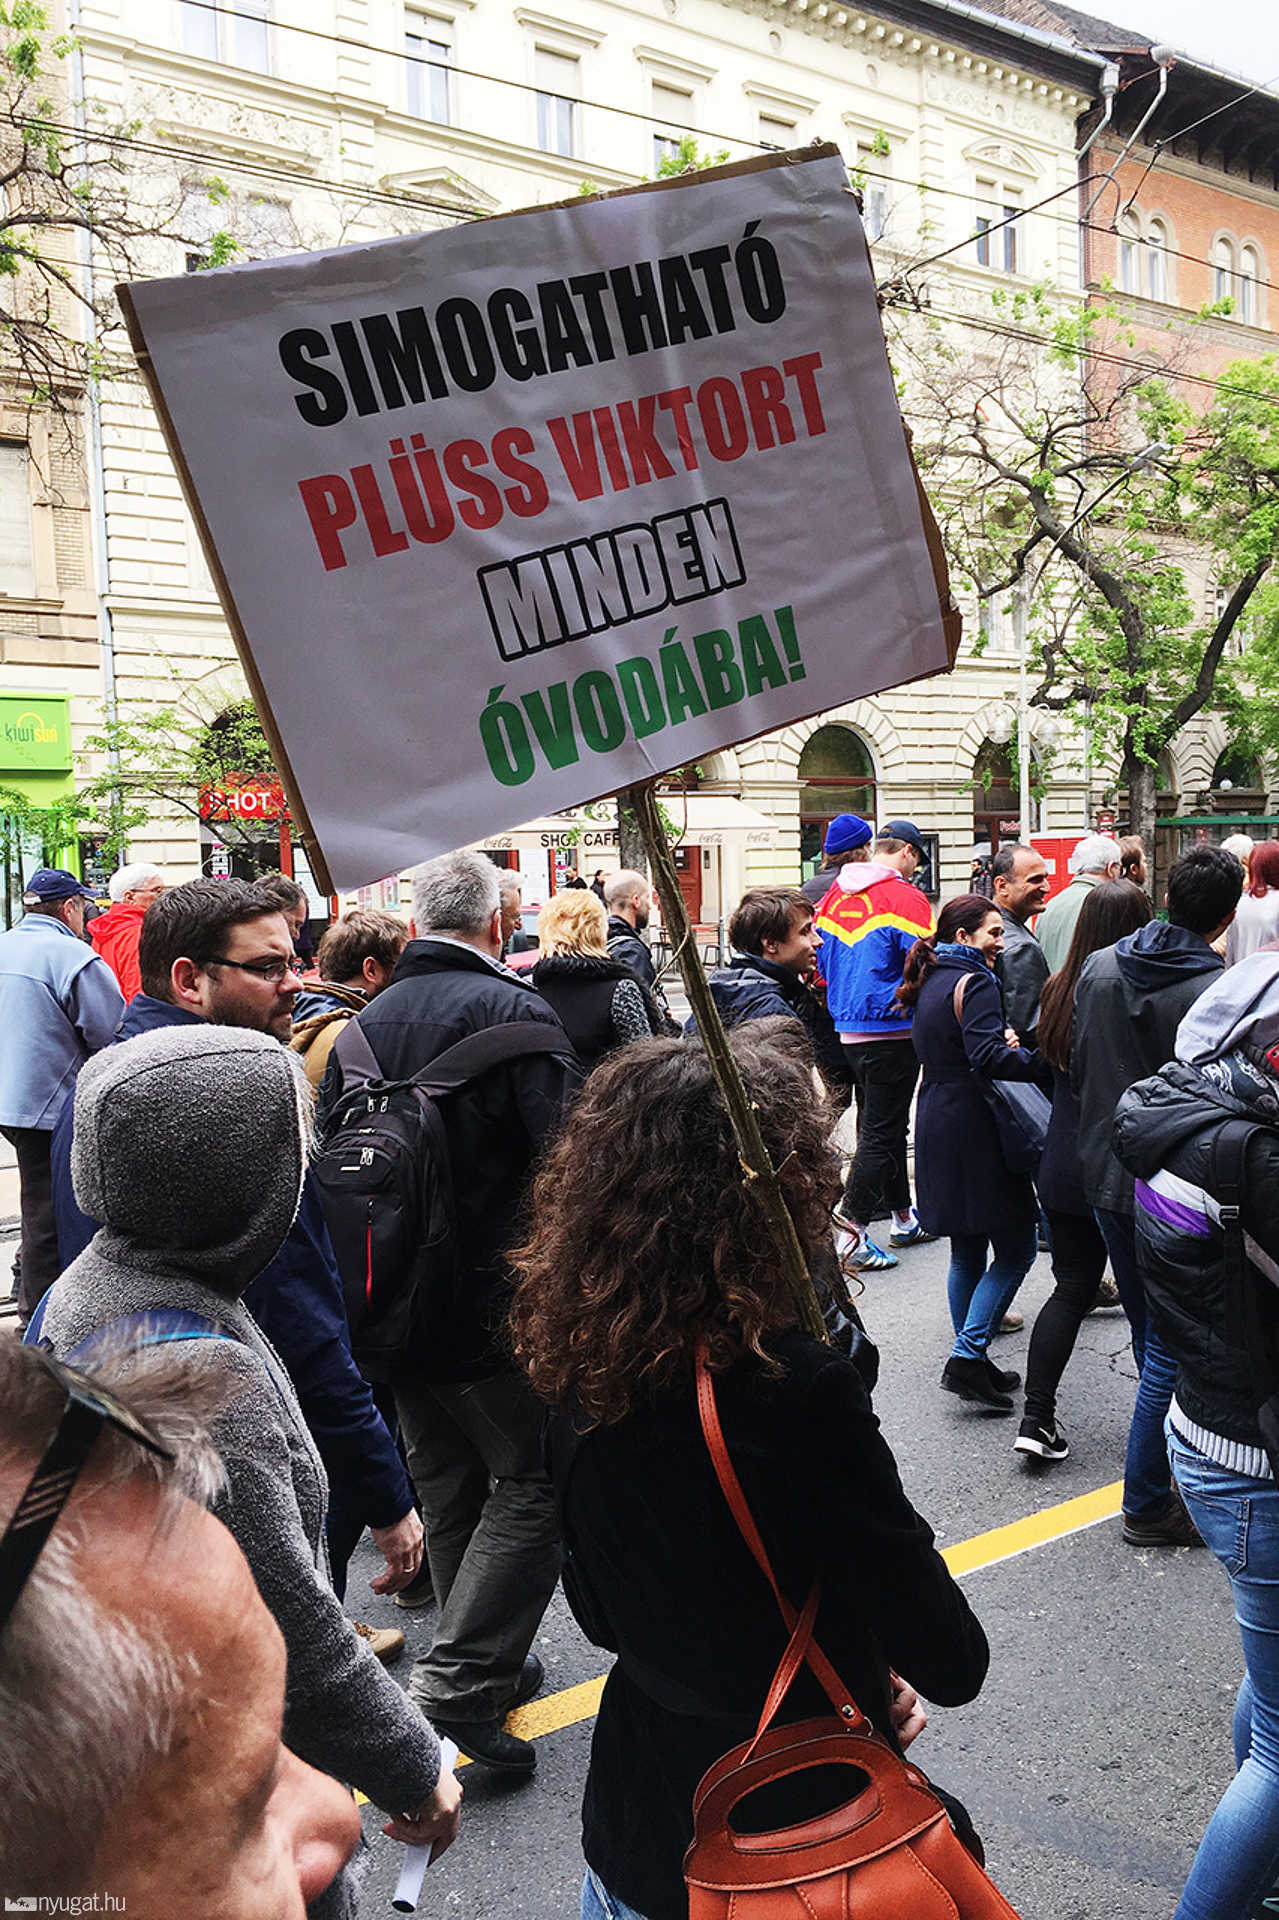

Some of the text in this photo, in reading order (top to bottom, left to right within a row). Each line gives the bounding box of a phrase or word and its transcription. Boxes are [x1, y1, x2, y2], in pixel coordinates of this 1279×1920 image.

[278, 219, 787, 428] SIMOGATHATÓ
[297, 352, 827, 572] PLÜSS VIKTORT
[477, 497, 747, 662] MINDEN
[479, 605, 807, 787] ÓVODÁBA!
[209, 792, 271, 811] SHOT
